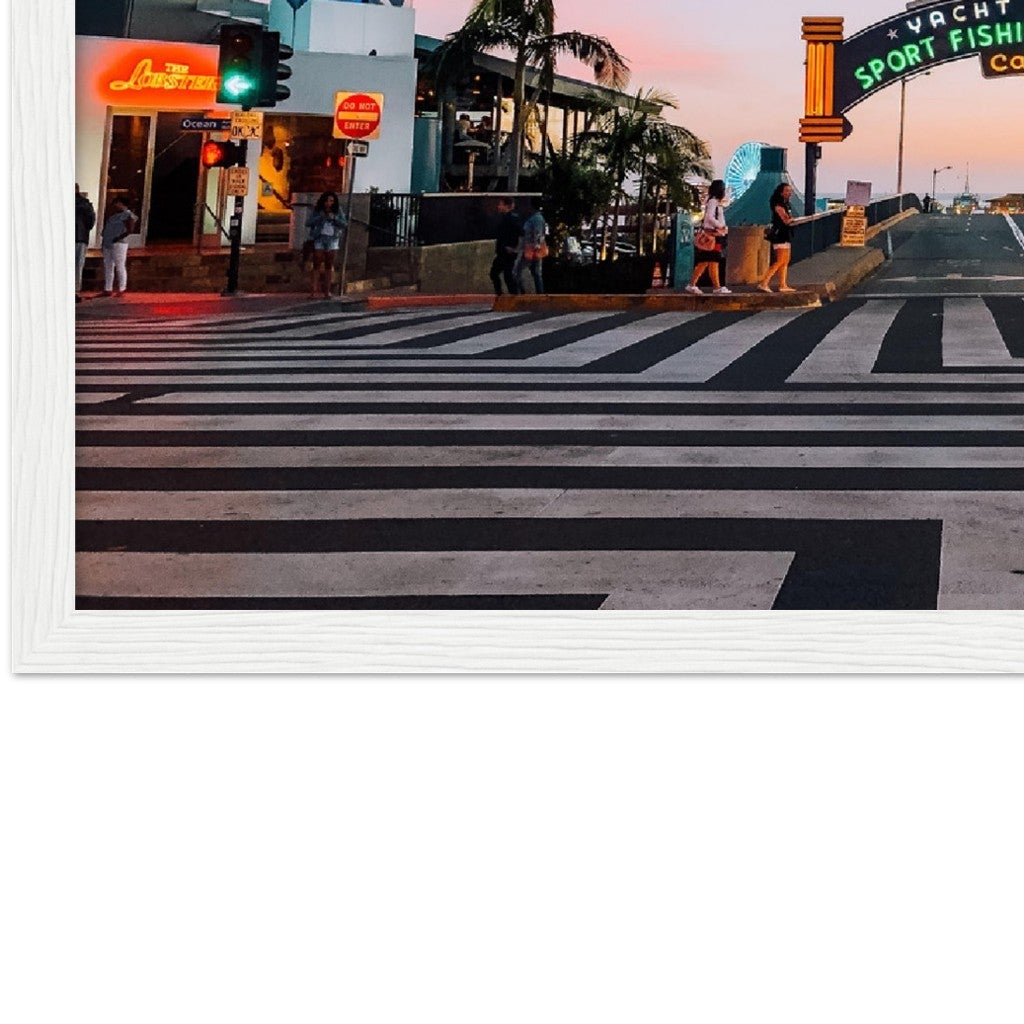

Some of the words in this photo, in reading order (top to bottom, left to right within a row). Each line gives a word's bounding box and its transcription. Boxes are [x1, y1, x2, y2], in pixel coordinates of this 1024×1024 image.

[907, 0, 1010, 34] YACHT
[164, 62, 190, 74] THE
[853, 36, 935, 91] SPORT
[342, 101, 356, 110] DO
[358, 102, 376, 111] NOT
[182, 119, 217, 129] Ocean
[343, 121, 370, 130] ENTER
